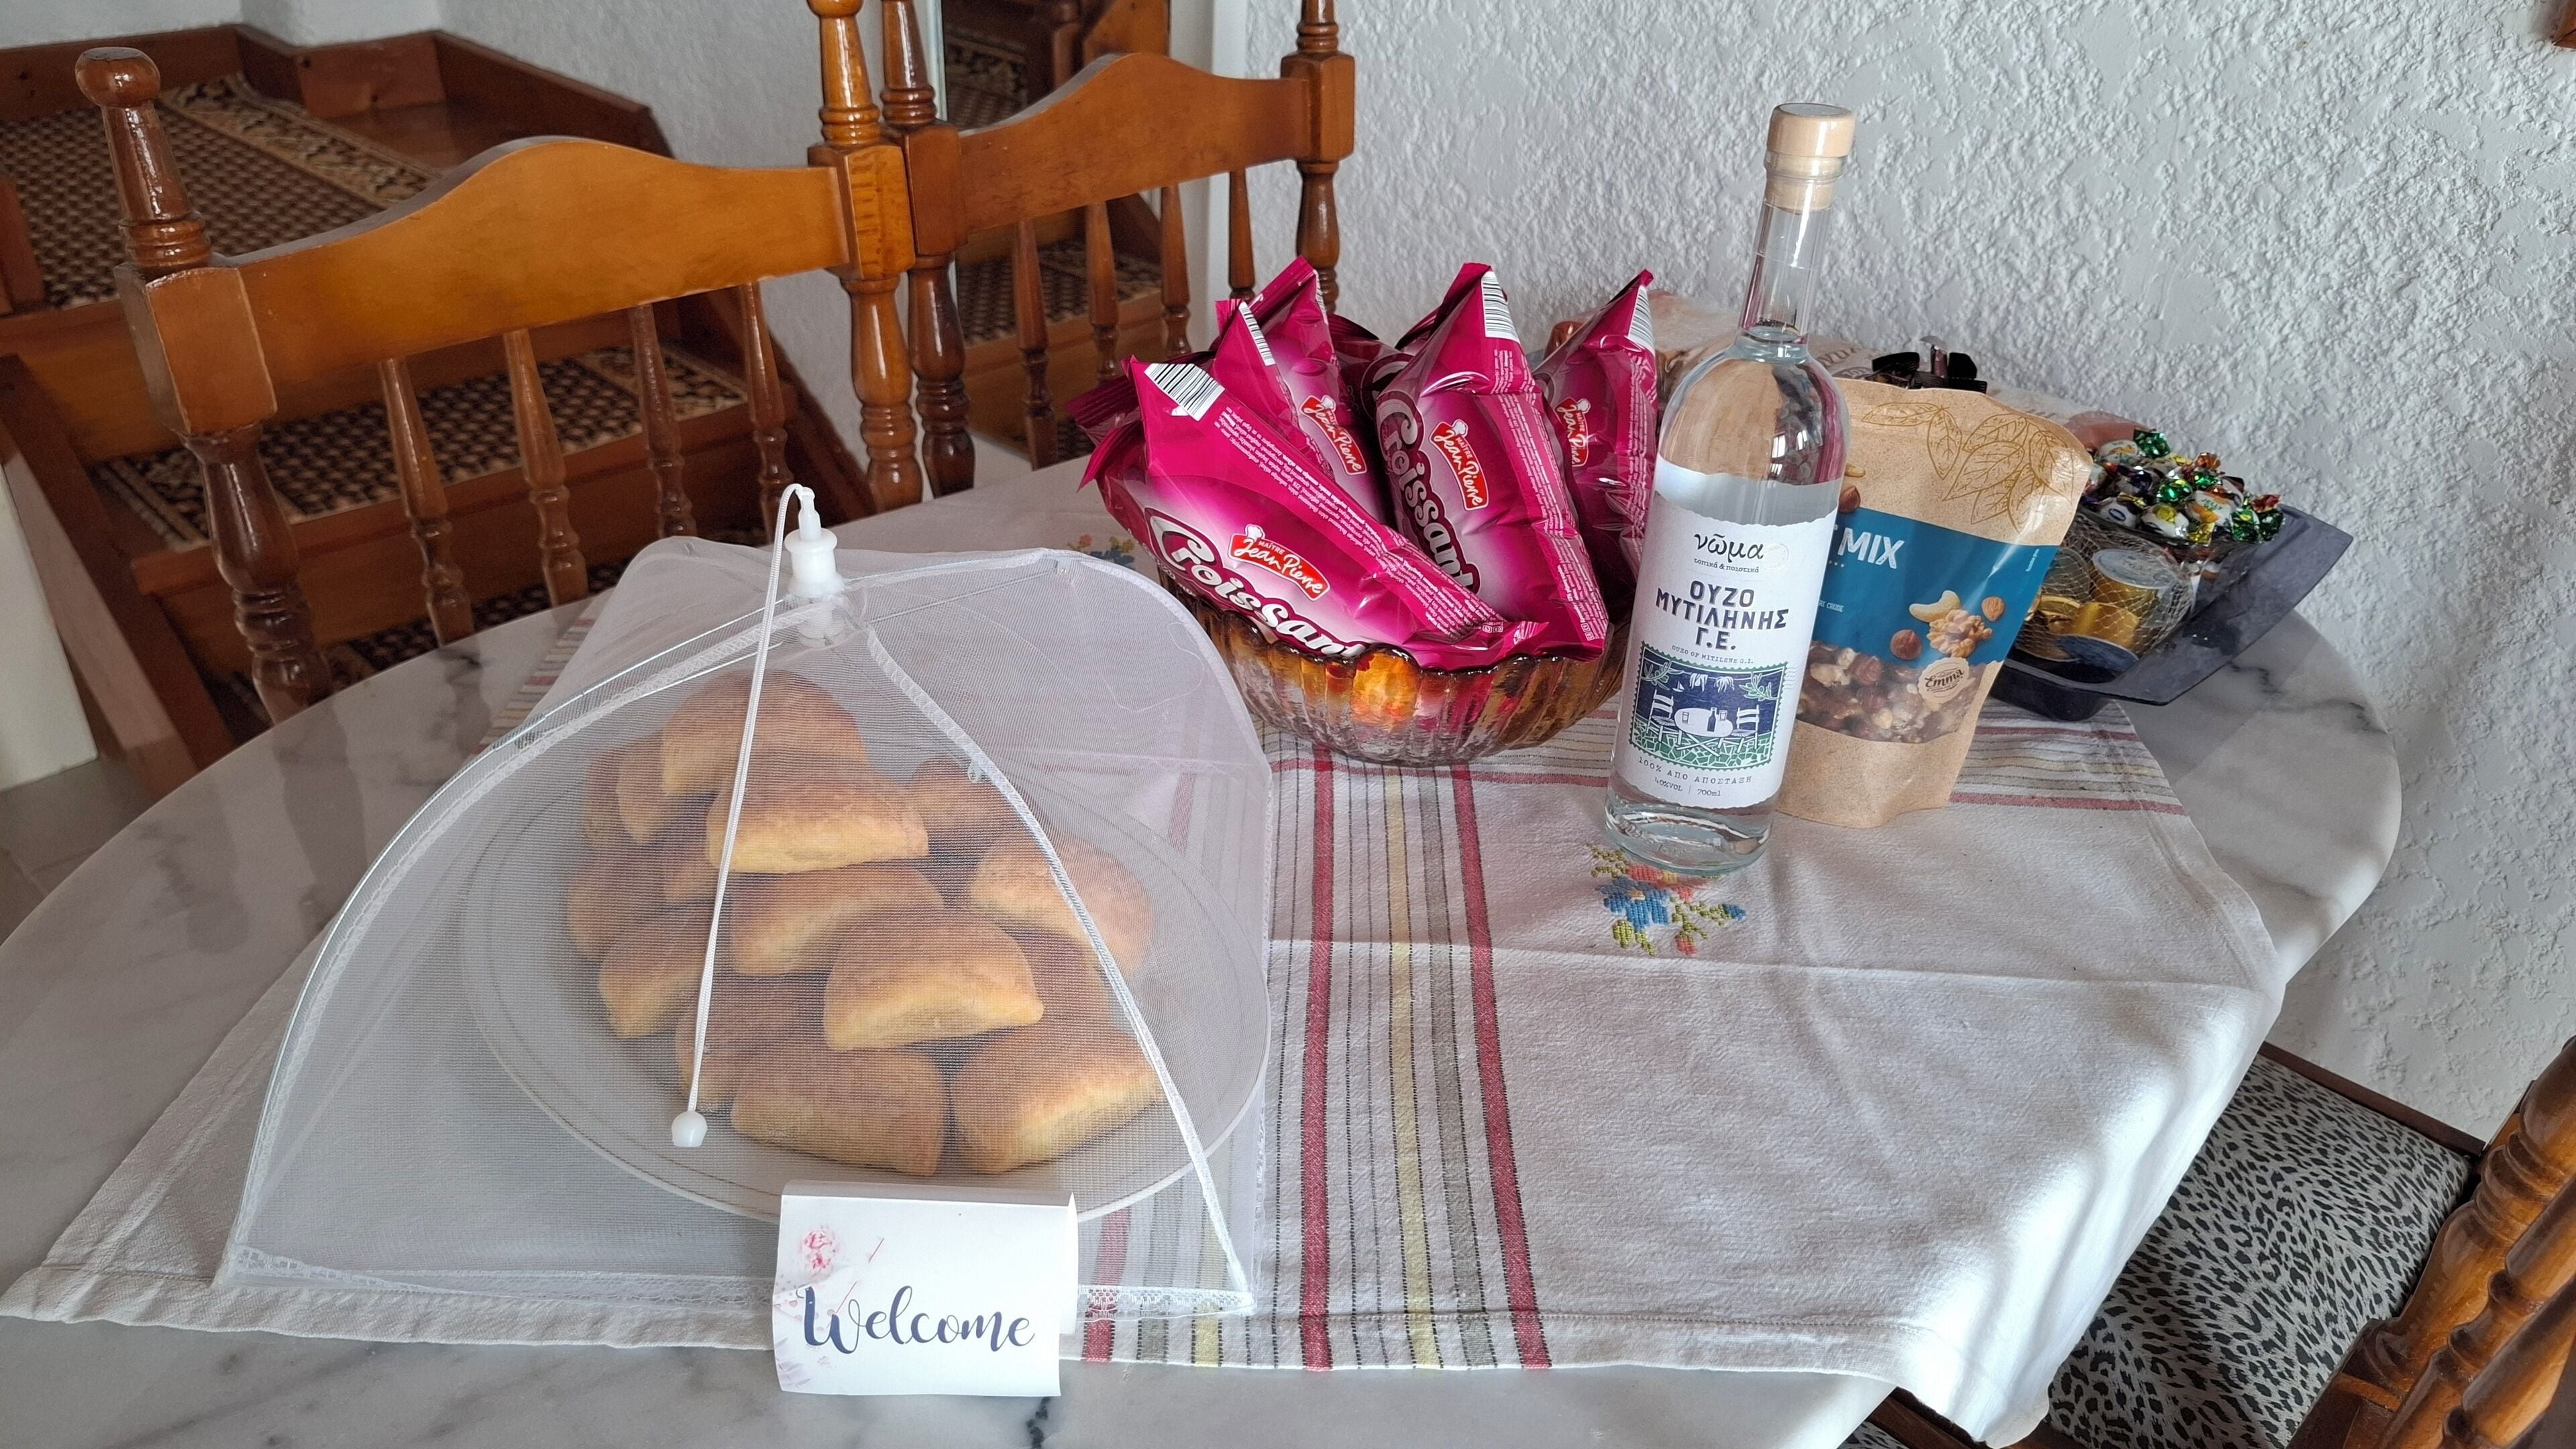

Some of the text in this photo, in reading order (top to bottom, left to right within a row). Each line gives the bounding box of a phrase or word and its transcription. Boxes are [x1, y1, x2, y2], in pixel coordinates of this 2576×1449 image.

[1303, 404, 1336, 439] Jean
[1334, 431, 1362, 472] Pierre
[1455, 437, 1473, 459] MAÎTRE
[1434, 430, 1483, 506] Jean Pierre
[1258, 539, 1285, 555] MAÎTRE
[1837, 527, 1906, 570] MIX
[1234, 538, 1282, 570] Jean
[1281, 553, 1324, 594] Pierre
[1689, 580, 1755, 608] ΟΥΖΟ
[1655, 587, 1789, 630] ΜΥΤΙΛΗΝΗΣ
[1695, 627, 1736, 650] Γ.Ε.
[1672, 645, 1688, 655] OUZO
[1701, 654, 1738, 664] MITILENE
[1924, 669, 1965, 688] Emma
[1638, 756, 1752, 785] 100% ΑΠΟ ΑΠΟΣΤΑΞΗ
[1654, 777, 1721, 797] 40%VOL 700ml
[796, 1285, 1036, 1354] Welcome
